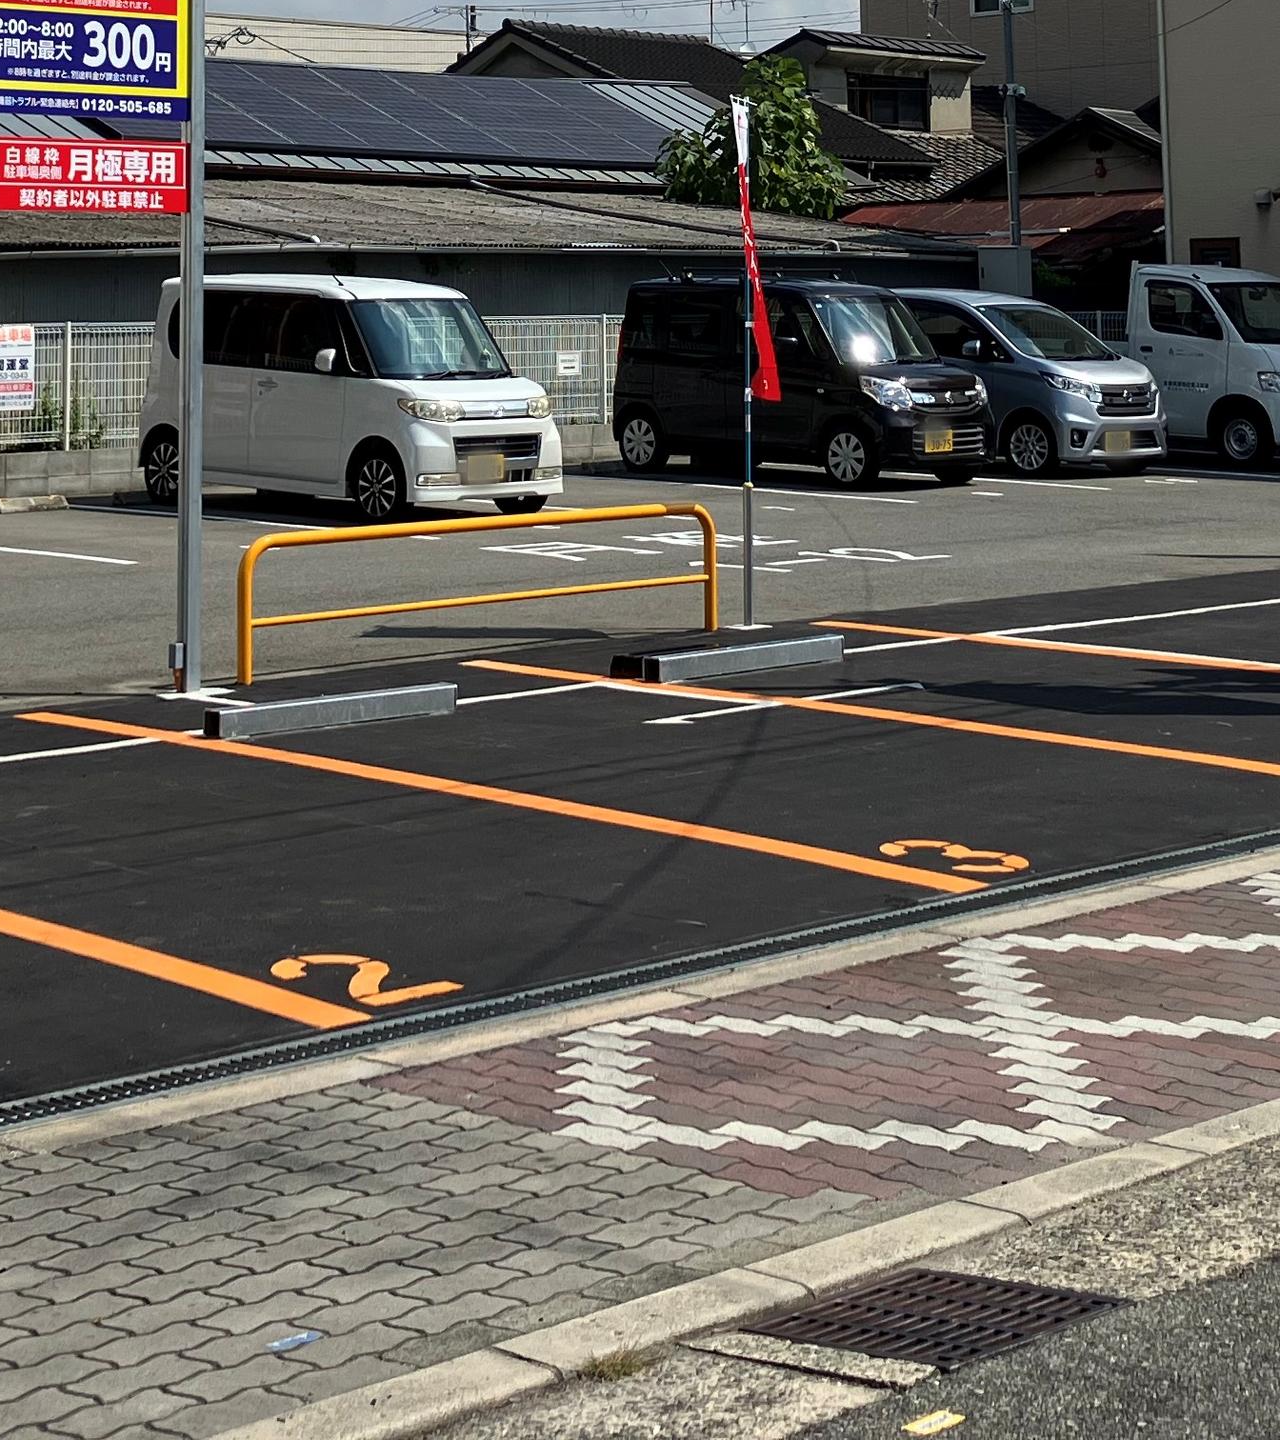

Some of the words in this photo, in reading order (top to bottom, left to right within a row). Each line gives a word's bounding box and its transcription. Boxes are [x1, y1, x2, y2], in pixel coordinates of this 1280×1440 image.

[82, 20, 172, 73] 300円
[81, 98, 172, 115] 0120-505-685
[67, 148, 176, 184] 月極専用
[20, 188, 165, 209] 契約者以外駐車禁止
[878, 839, 1030, 873] 3
[270, 953, 464, 1007] 2
